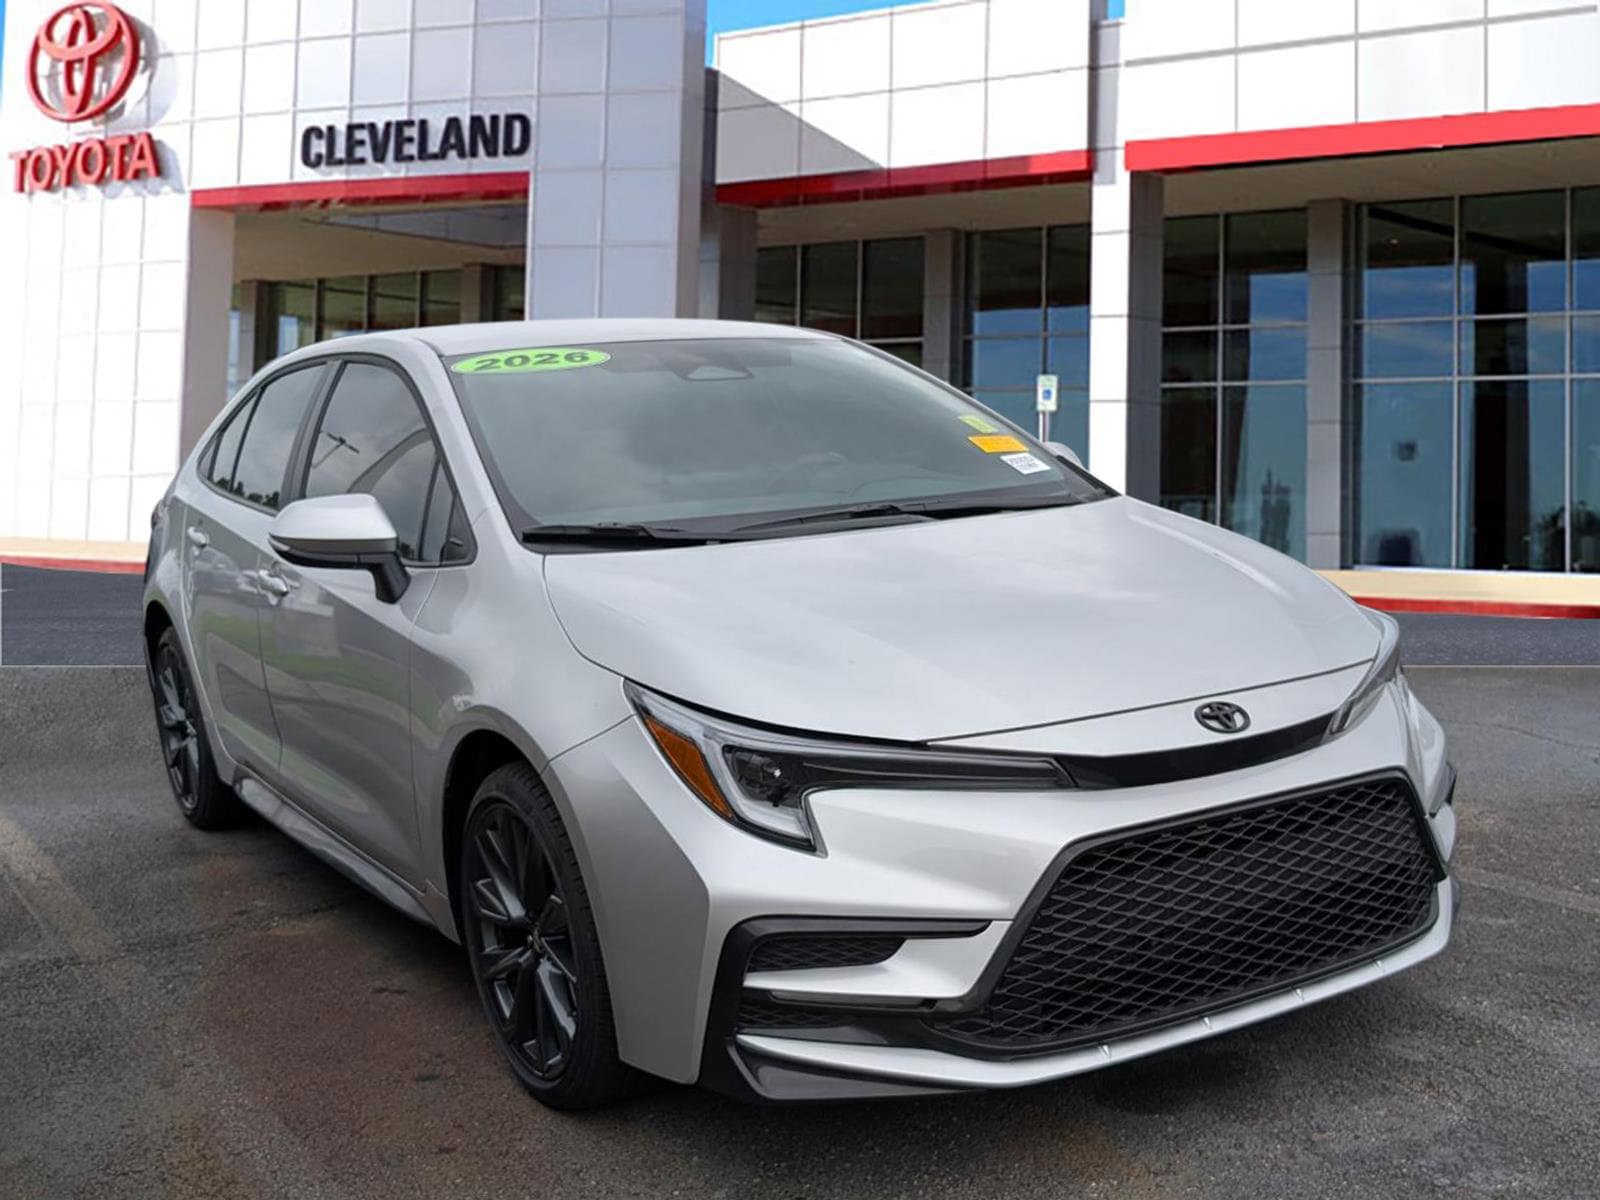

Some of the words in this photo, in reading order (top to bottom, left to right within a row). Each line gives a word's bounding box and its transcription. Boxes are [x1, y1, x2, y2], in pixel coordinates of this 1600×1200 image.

[9, 131, 161, 193] TOYOTA
[301, 113, 531, 168] CLEVELAND
[474, 351, 590, 371] 2026
